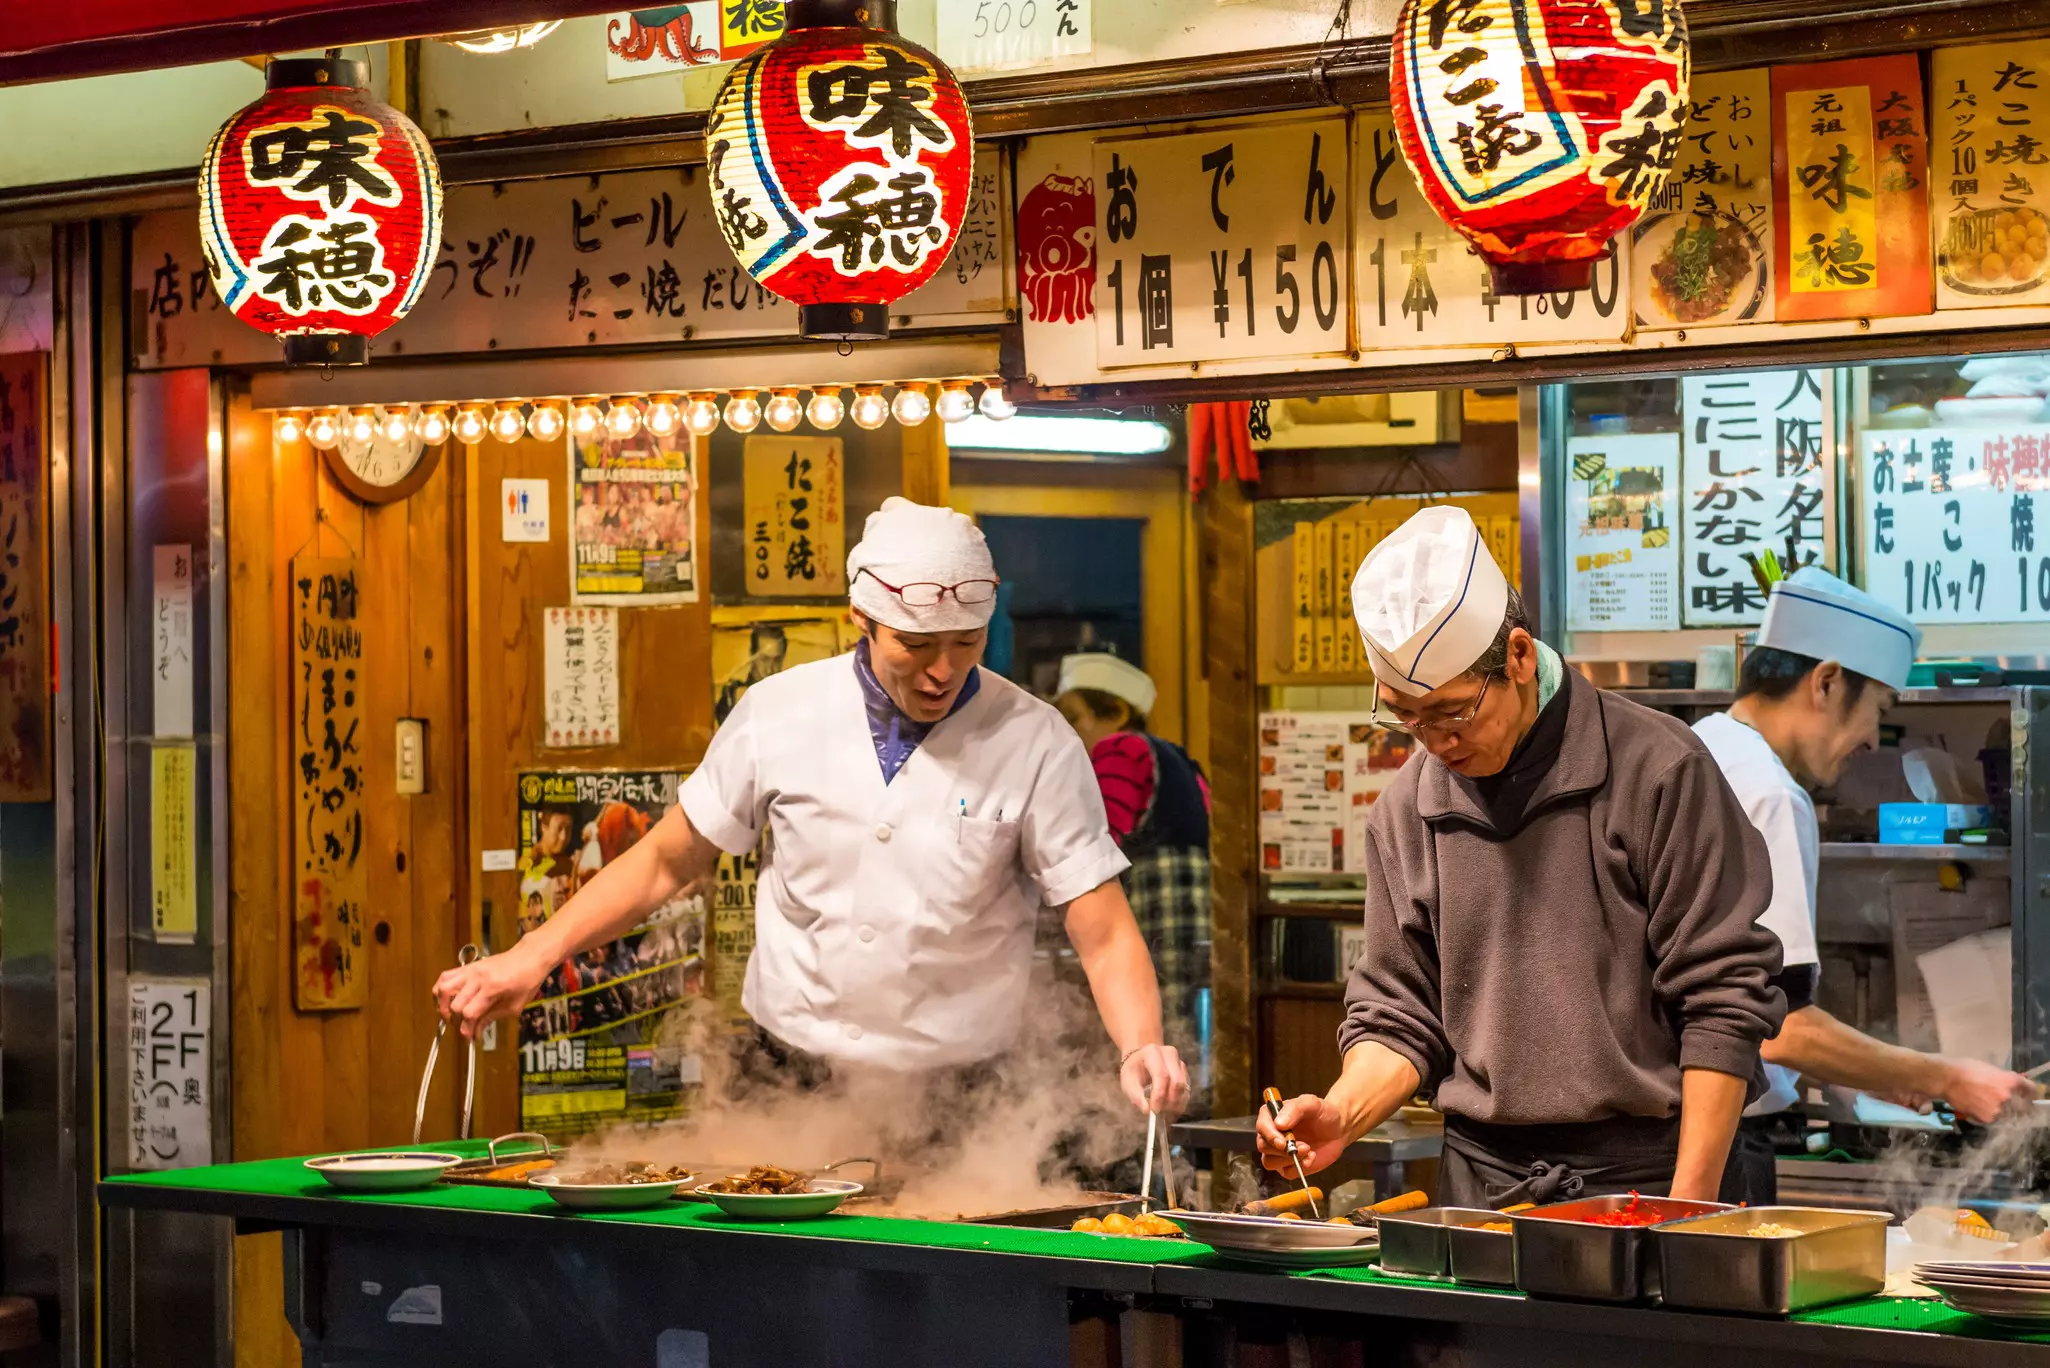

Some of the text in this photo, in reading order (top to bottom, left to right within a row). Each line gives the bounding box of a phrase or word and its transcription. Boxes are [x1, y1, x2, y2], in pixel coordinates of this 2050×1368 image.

[975, 0, 1037, 39] 500
[809, 46, 949, 271] 味穂
[1682, 95, 1730, 218] どて焼き
[1985, 61, 2049, 205] たこ焼き
[249, 110, 394, 311] 味穂
[571, 191, 688, 253] ビール
[981, 173, 999, 262] だいこん
[1106, 131, 1336, 244] おでん
[1793, 93, 1875, 288] 元祖 味穂
[569, 260, 688, 322] たこ焼
[1107, 241, 1339, 351] 1個 ¥150
[1369, 231, 1438, 332] 1本
[1873, 494, 2035, 554] たこ焼
[1905, 558, 1986, 615] 1パック
[158, 597, 170, 681] どうぞ
